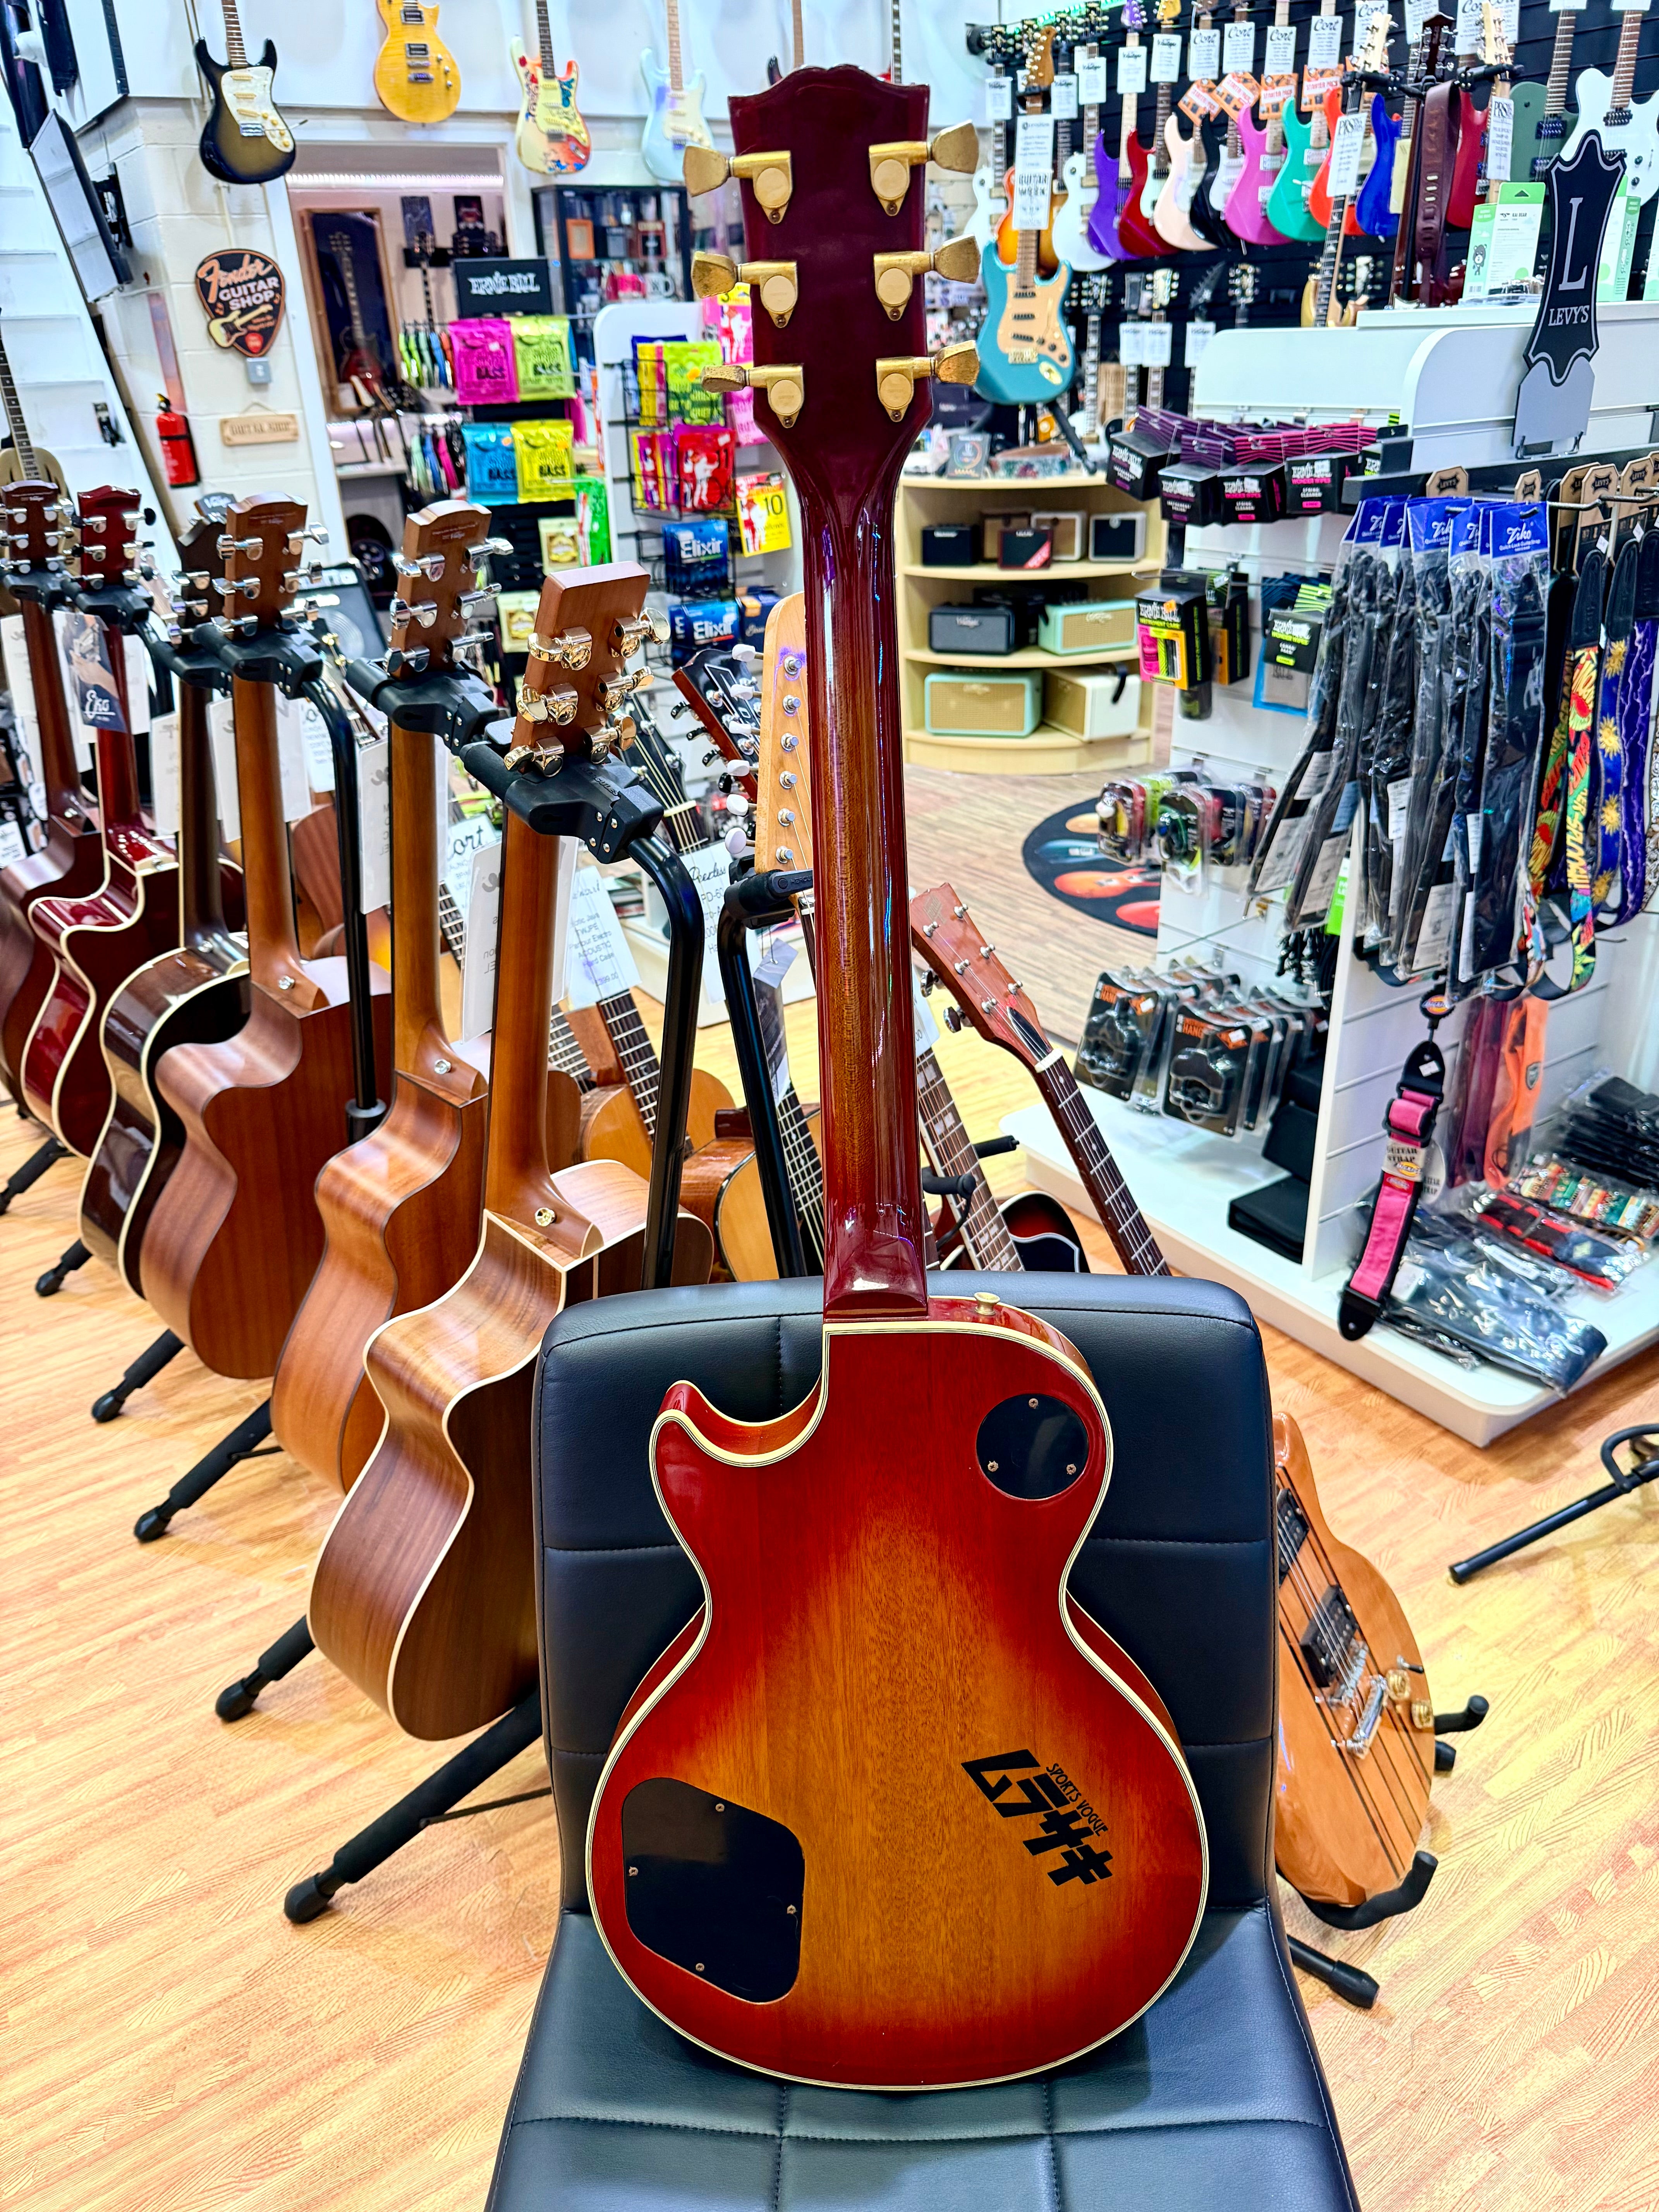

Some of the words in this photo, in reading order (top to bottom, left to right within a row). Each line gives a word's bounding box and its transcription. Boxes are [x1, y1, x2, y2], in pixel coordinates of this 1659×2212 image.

[1228, 26, 1252, 38] Cort
[1314, 18, 1339, 32] Cort
[1193, 32, 1216, 45] Cort
[1269, 29, 1293, 42] Cort
[1494, 101, 1508, 118] PRS
[1338, 118, 1354, 136] PRS
[1558, 197, 1588, 291] L
[197, 254, 273, 303] Fender
[218, 276, 280, 301] GUITAR
[468, 271, 510, 295] ERNIE
[508, 272, 541, 293] BALL
[229, 290, 275, 310] SHOP
[1548, 305, 1590, 326] LEVY'S
[1365, 457, 1381, 471] ERN
[764, 494, 783, 516] 10
[1432, 518, 1451, 539] Zik
[1506, 522, 1532, 544] Ziko
[681, 537, 723, 559] Elixir
[693, 620, 735, 640] Elixir
[453, 825, 484, 856] ort
[790, 875, 812, 883] HERCU
[578, 941, 612, 959] ACOUSTIC
[1386, 1146, 1417, 1154] GUITAR
[1387, 1154, 1415, 1162] STRAP
[1046, 1763, 1082, 1802] SPORTS
[1076, 1799, 1108, 1837] VOGUE
[961, 1749, 1113, 1886] ムラサキ
